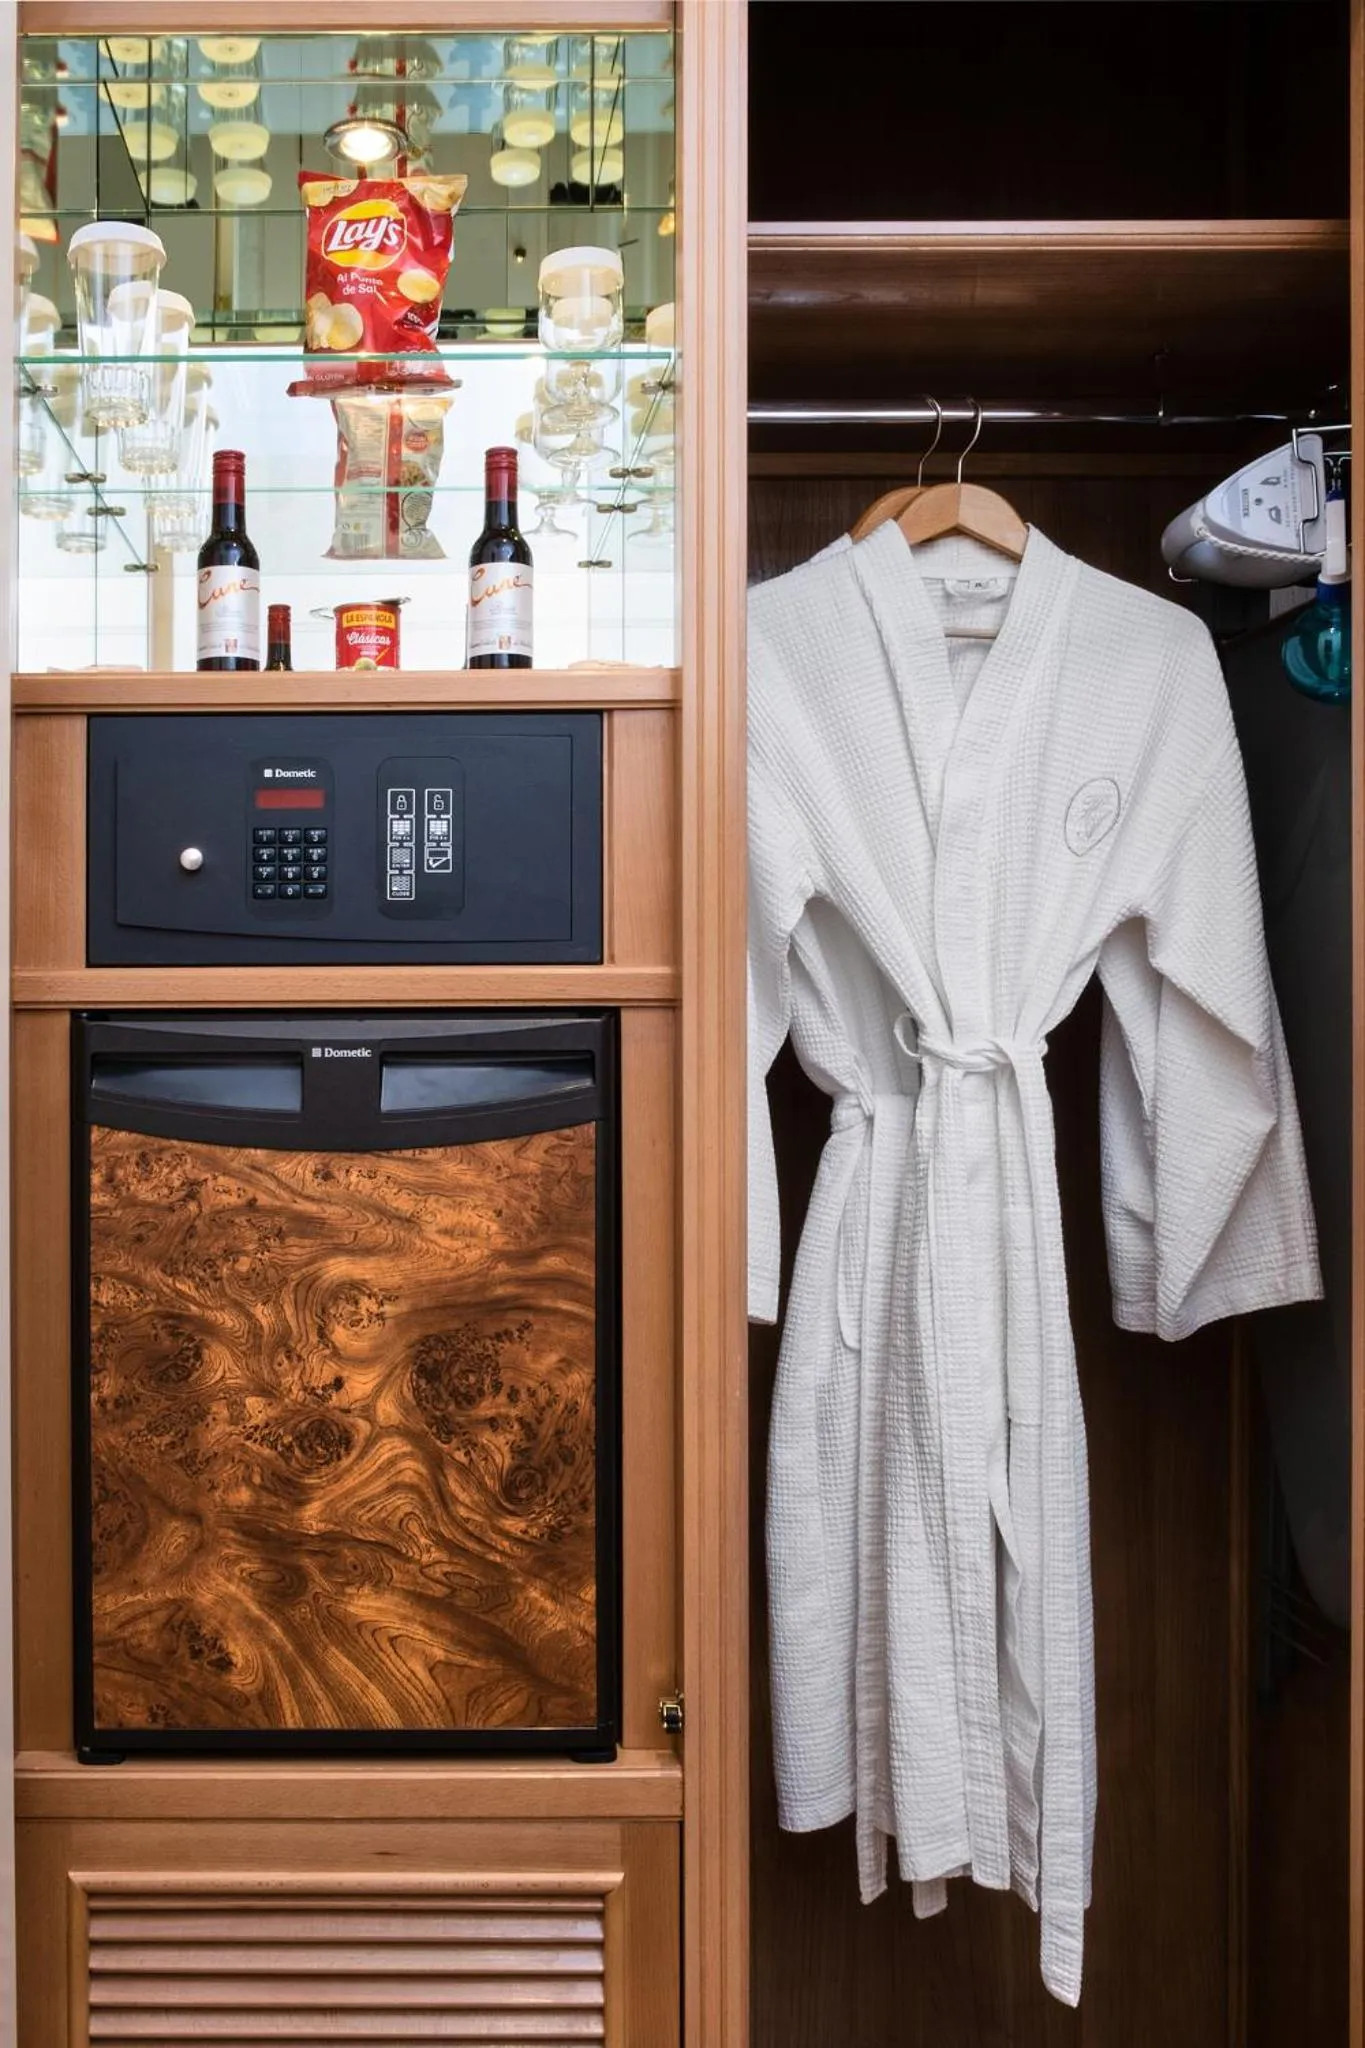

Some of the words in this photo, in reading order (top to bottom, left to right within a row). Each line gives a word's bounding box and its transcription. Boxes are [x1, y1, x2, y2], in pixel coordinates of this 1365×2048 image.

[327, 215, 402, 251] Lay's
[337, 273, 348, 284] Al
[350, 272, 384, 286] Punto
[342, 285, 356, 296] de
[358, 283, 377, 294] Sal
[199, 569, 260, 610] Cune
[470, 567, 533, 608] Cune
[346, 613, 354, 624] LA
[346, 631, 391, 646] Clásicas
[275, 768, 317, 778] Dometic
[324, 1047, 372, 1058] Dometic
